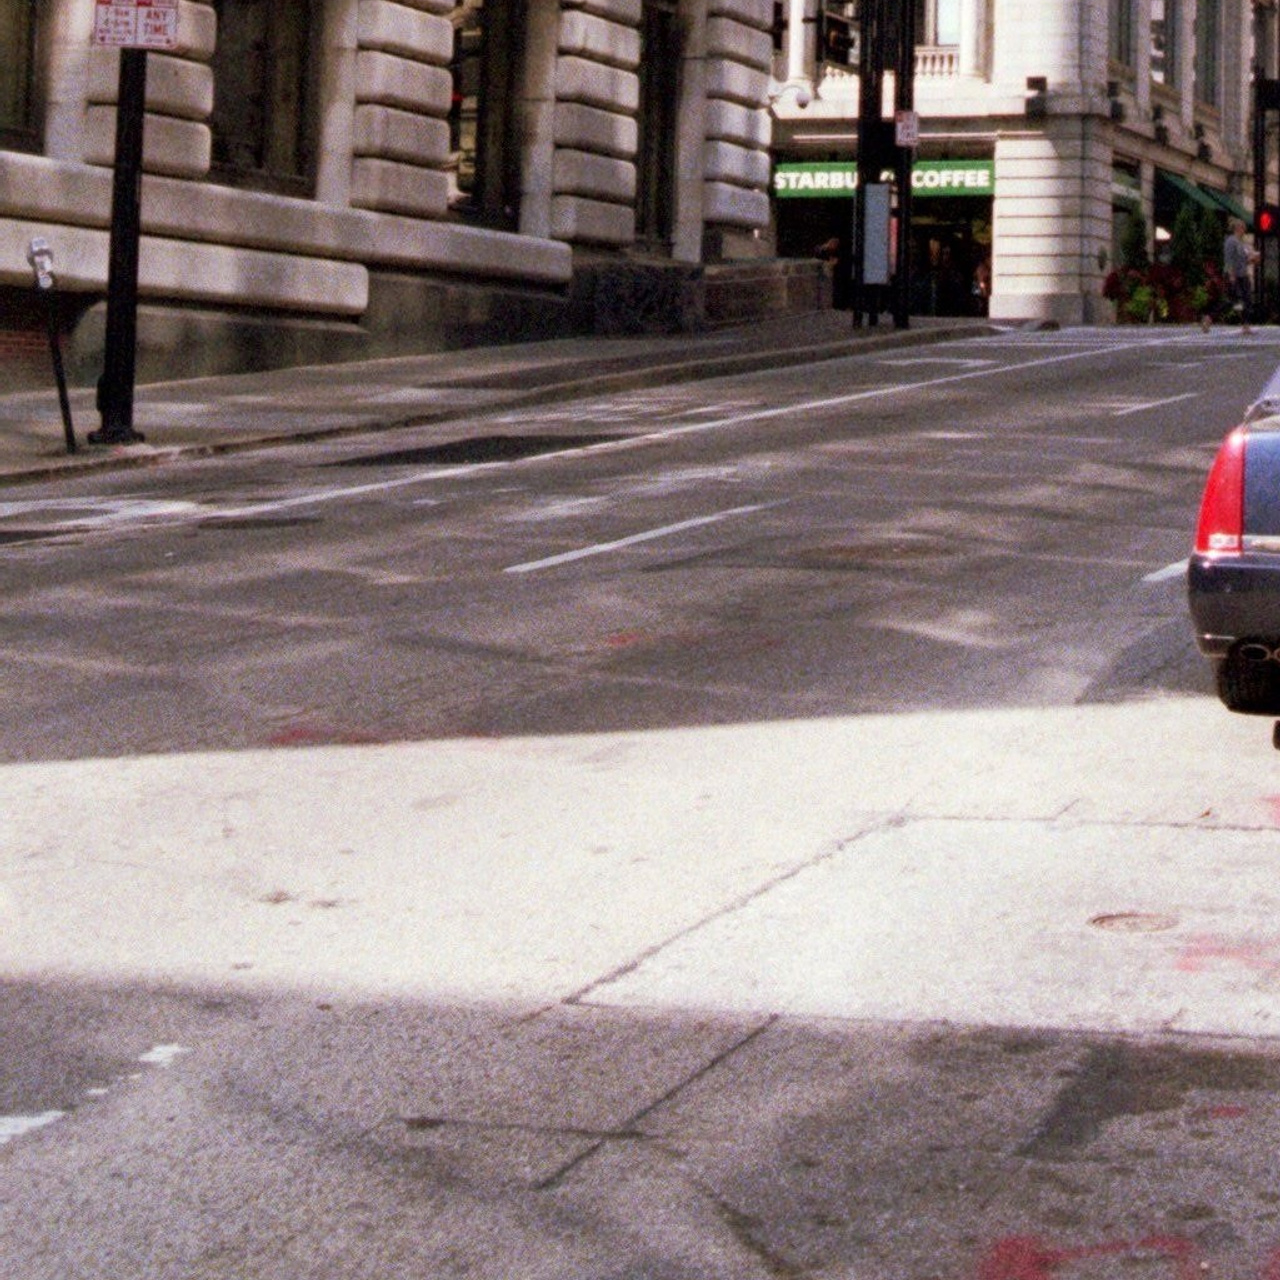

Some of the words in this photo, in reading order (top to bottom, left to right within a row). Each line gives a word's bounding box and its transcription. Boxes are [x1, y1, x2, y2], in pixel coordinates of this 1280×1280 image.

[146, 10, 167, 20] ANY
[143, 22, 168, 35] TIME
[774, 170, 895, 189] STARBU
[911, 169, 989, 188] COFFEE
